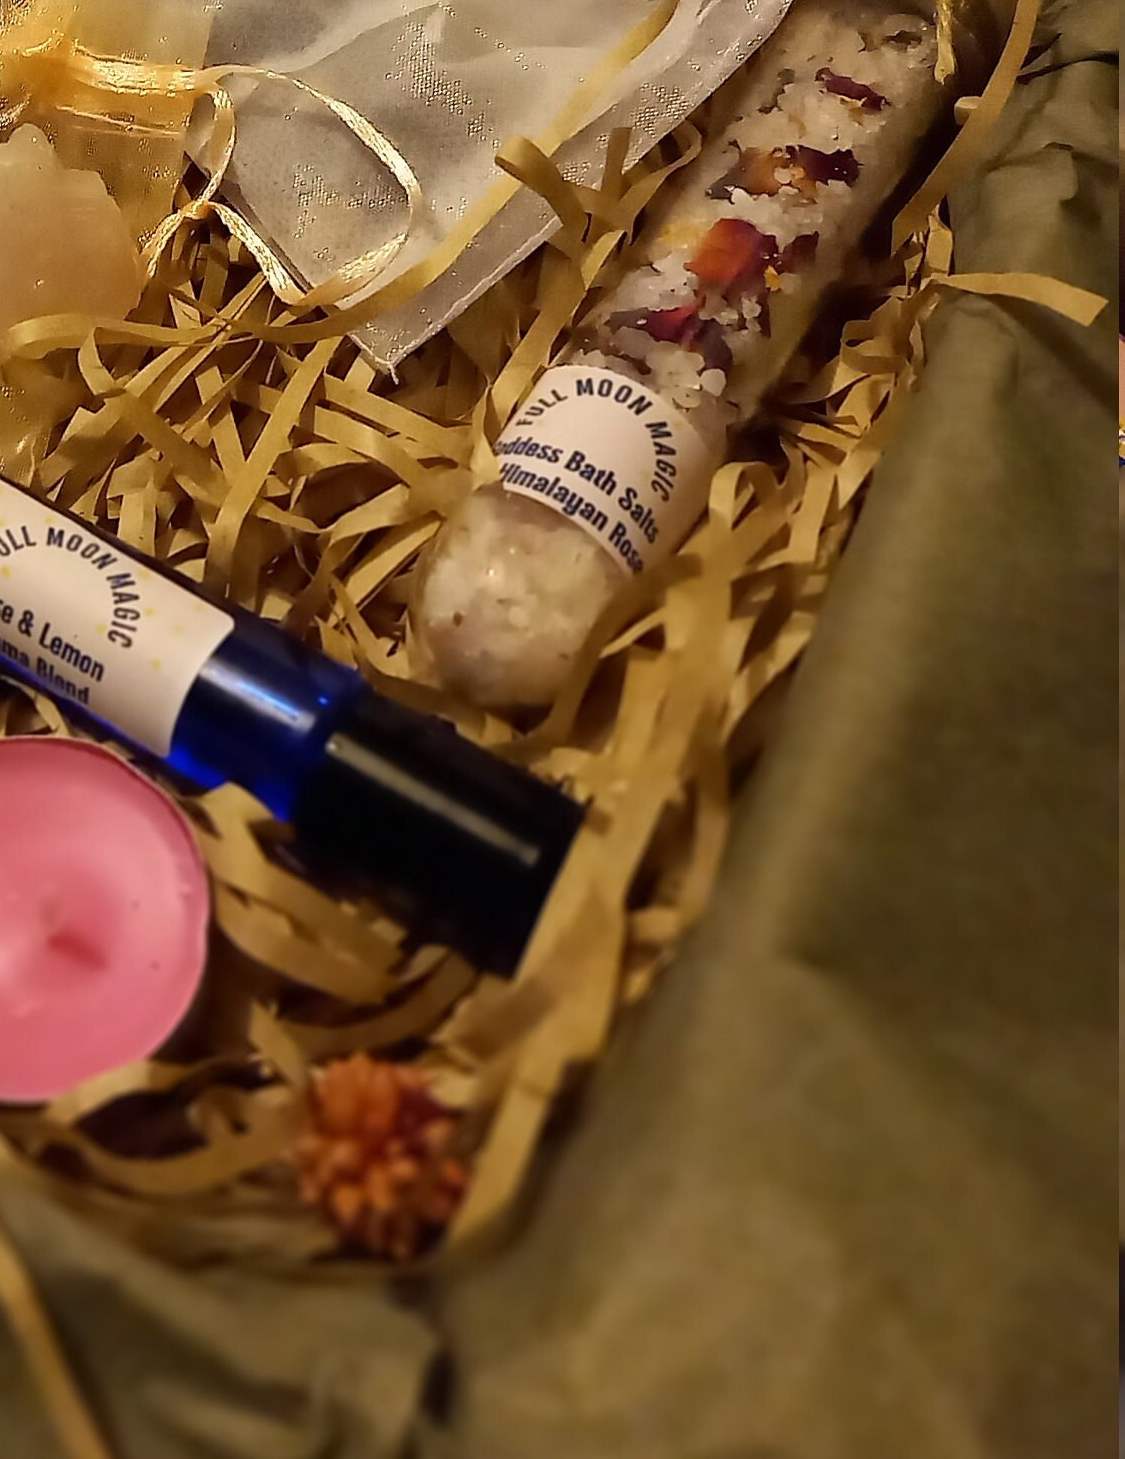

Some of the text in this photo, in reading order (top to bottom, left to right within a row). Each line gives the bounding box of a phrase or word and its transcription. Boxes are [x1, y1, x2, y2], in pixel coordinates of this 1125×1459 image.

[515, 378, 678, 503] FULL MOON MAGIC
[564, 450, 618, 496] Bath
[618, 487, 660, 544] Salts
[46, 527, 117, 571] MOON
[106, 572, 141, 650] MAGIC
[608, 519, 645, 575] Rose
[18, 610, 35, 638] &
[39, 622, 106, 683] Lemon
